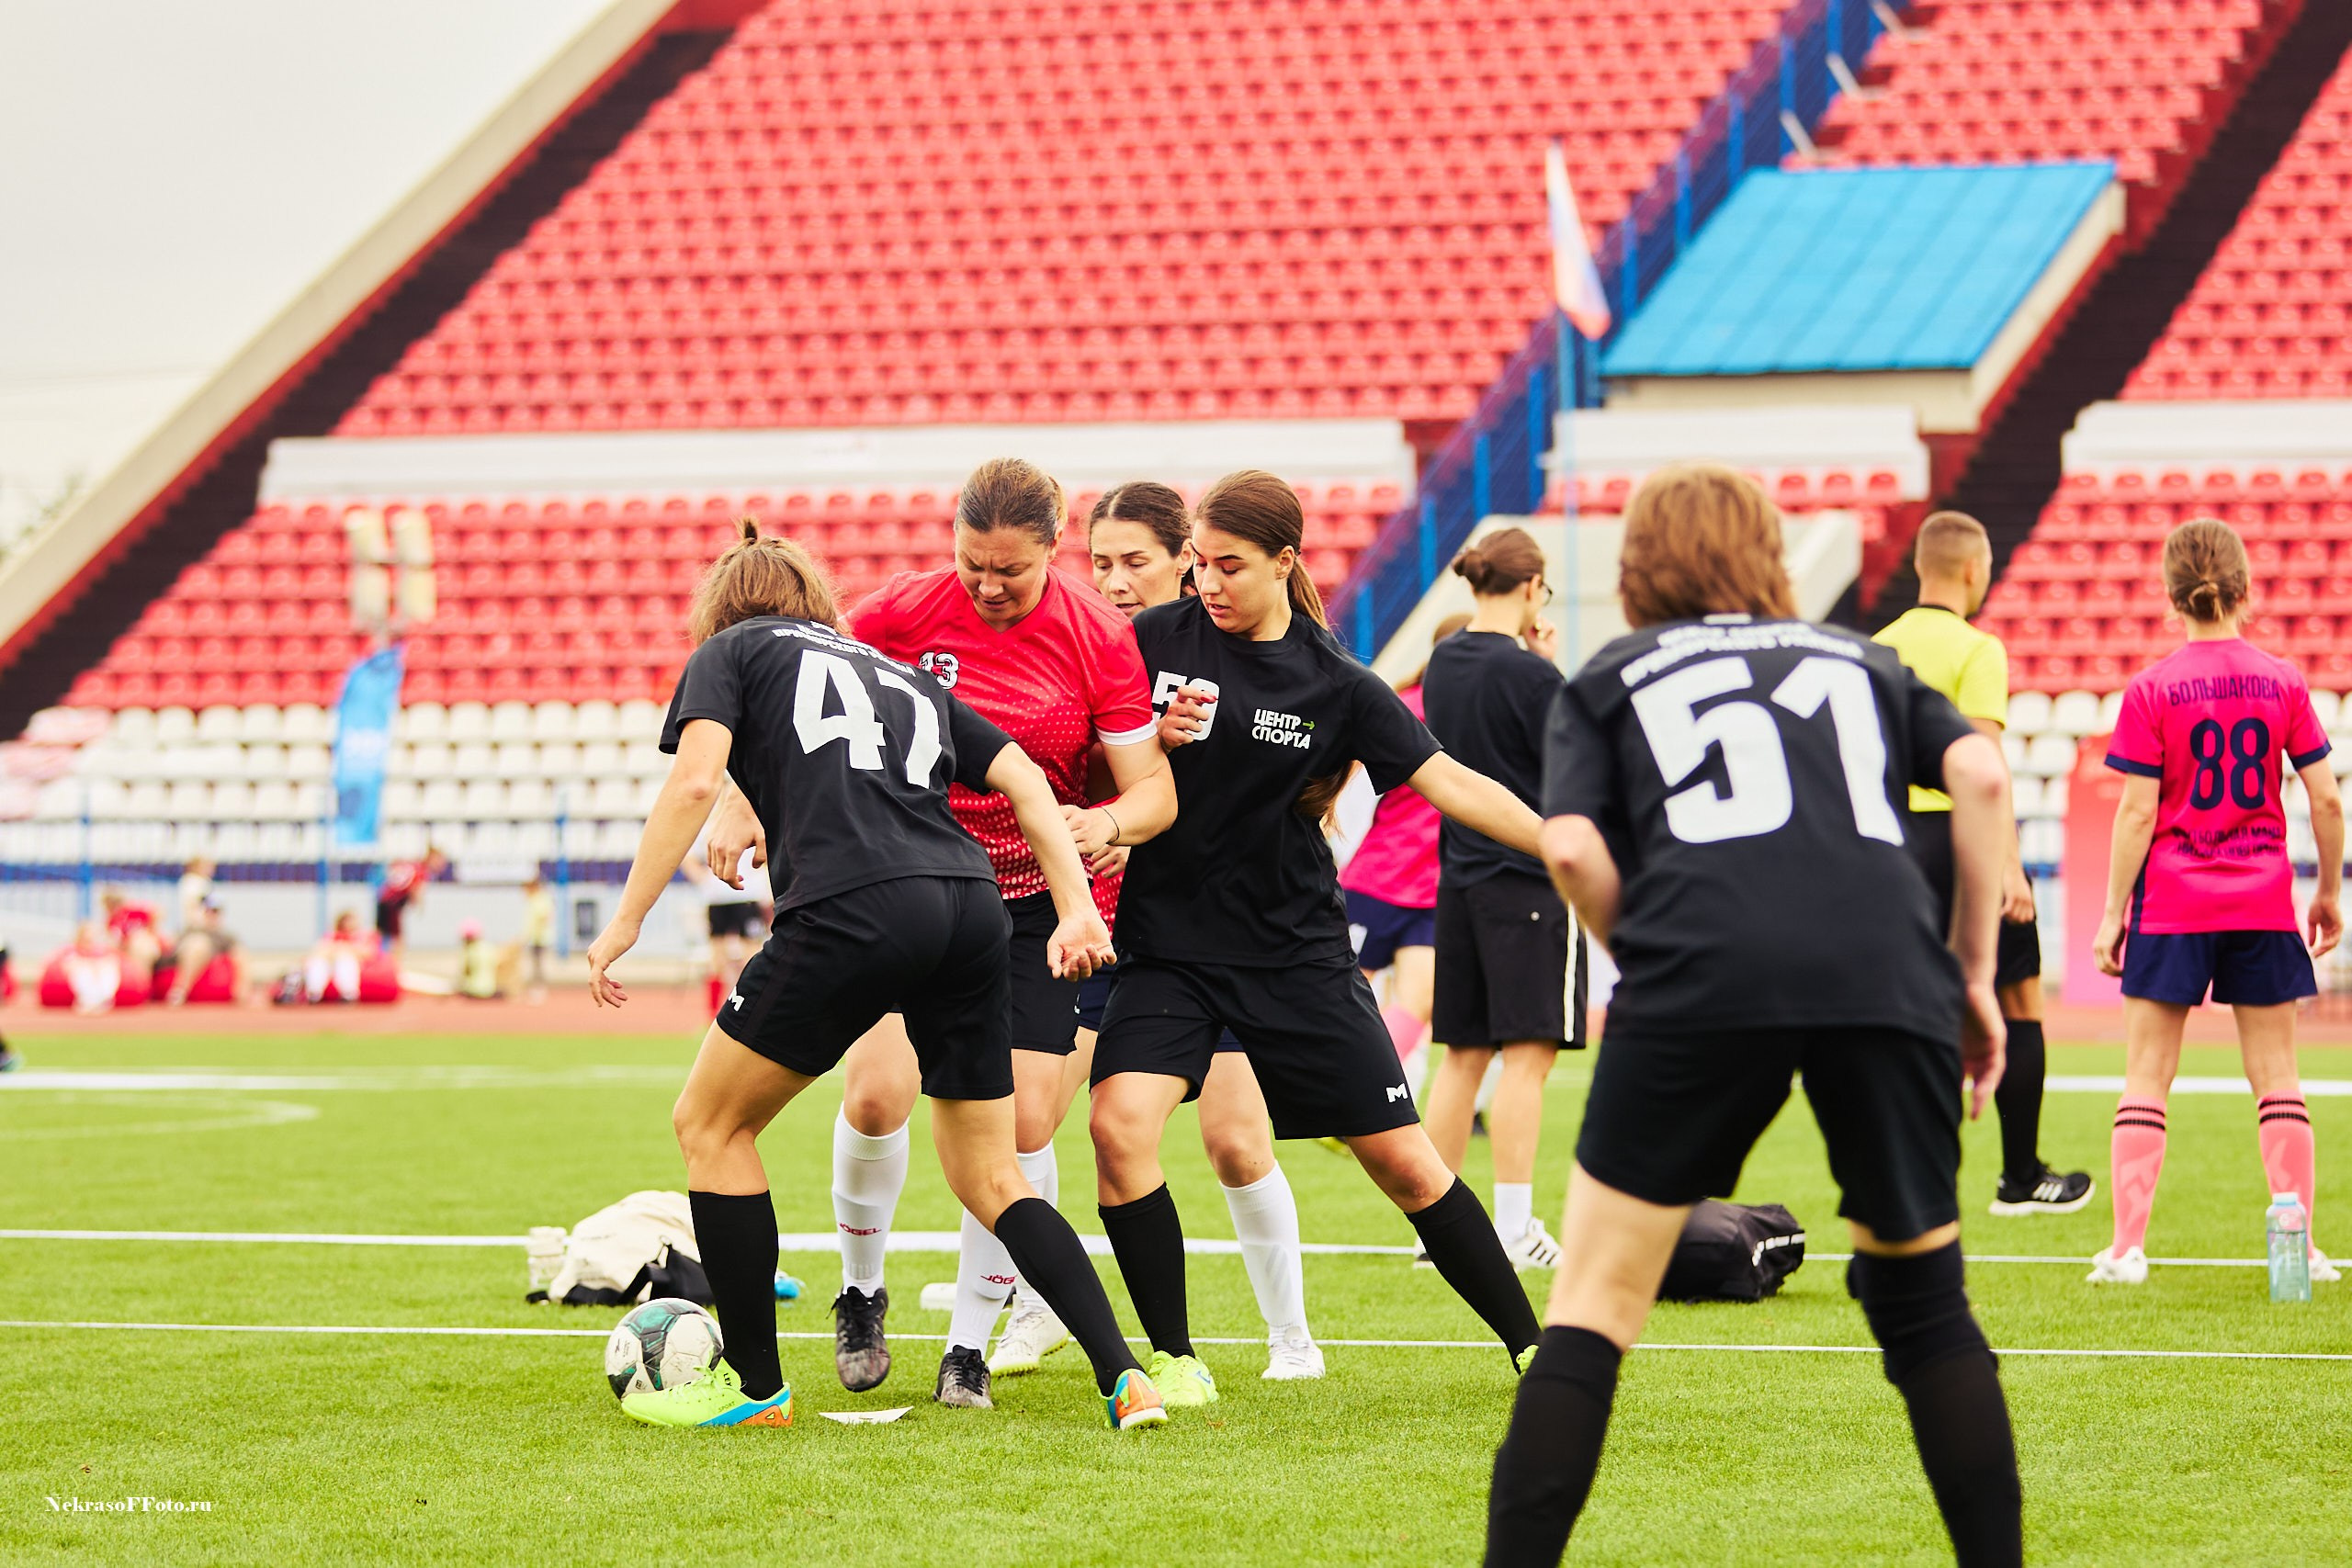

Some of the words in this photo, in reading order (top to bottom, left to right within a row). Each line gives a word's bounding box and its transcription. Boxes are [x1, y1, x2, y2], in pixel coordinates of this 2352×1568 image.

[919, 651, 959, 690] 13
[2168, 675, 2280, 706] БОЛЬШАКОВА
[793, 649, 943, 790] 47
[1251, 725, 1311, 750] СПОРТА
[1253, 708, 1302, 730] ЦЕНТР
[1630, 656, 1905, 847] 51
[2189, 716, 2270, 810] 88
